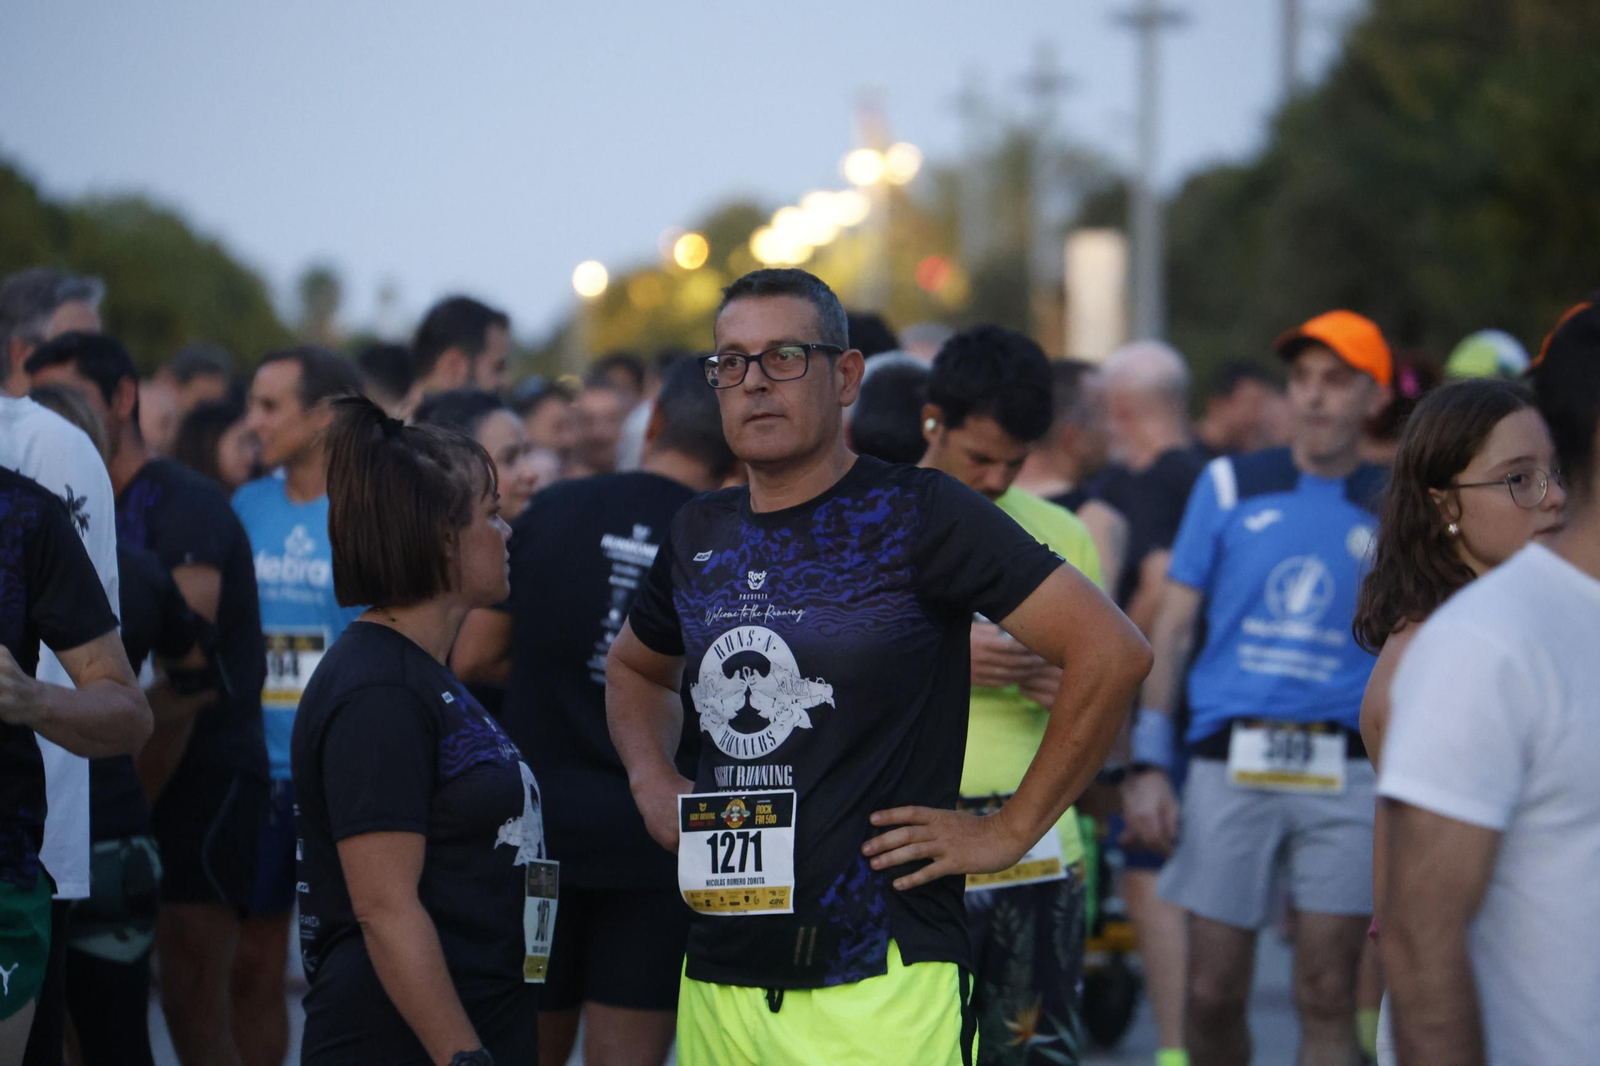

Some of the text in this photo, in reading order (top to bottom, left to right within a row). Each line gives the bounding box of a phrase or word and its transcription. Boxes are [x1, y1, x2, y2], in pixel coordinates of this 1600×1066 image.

[705, 606, 739, 626] Welcome
[748, 605, 762, 622] the
[764, 604, 806, 623] Running
[718, 730, 777, 756] RUNNERS
[736, 764, 793, 787] RUNNING
[755, 804, 773, 815] ROCK
[765, 814, 777, 825] 500
[706, 830, 763, 874] 1271
[706, 876, 765, 887] NICOLAS ROMERO ZORITA
